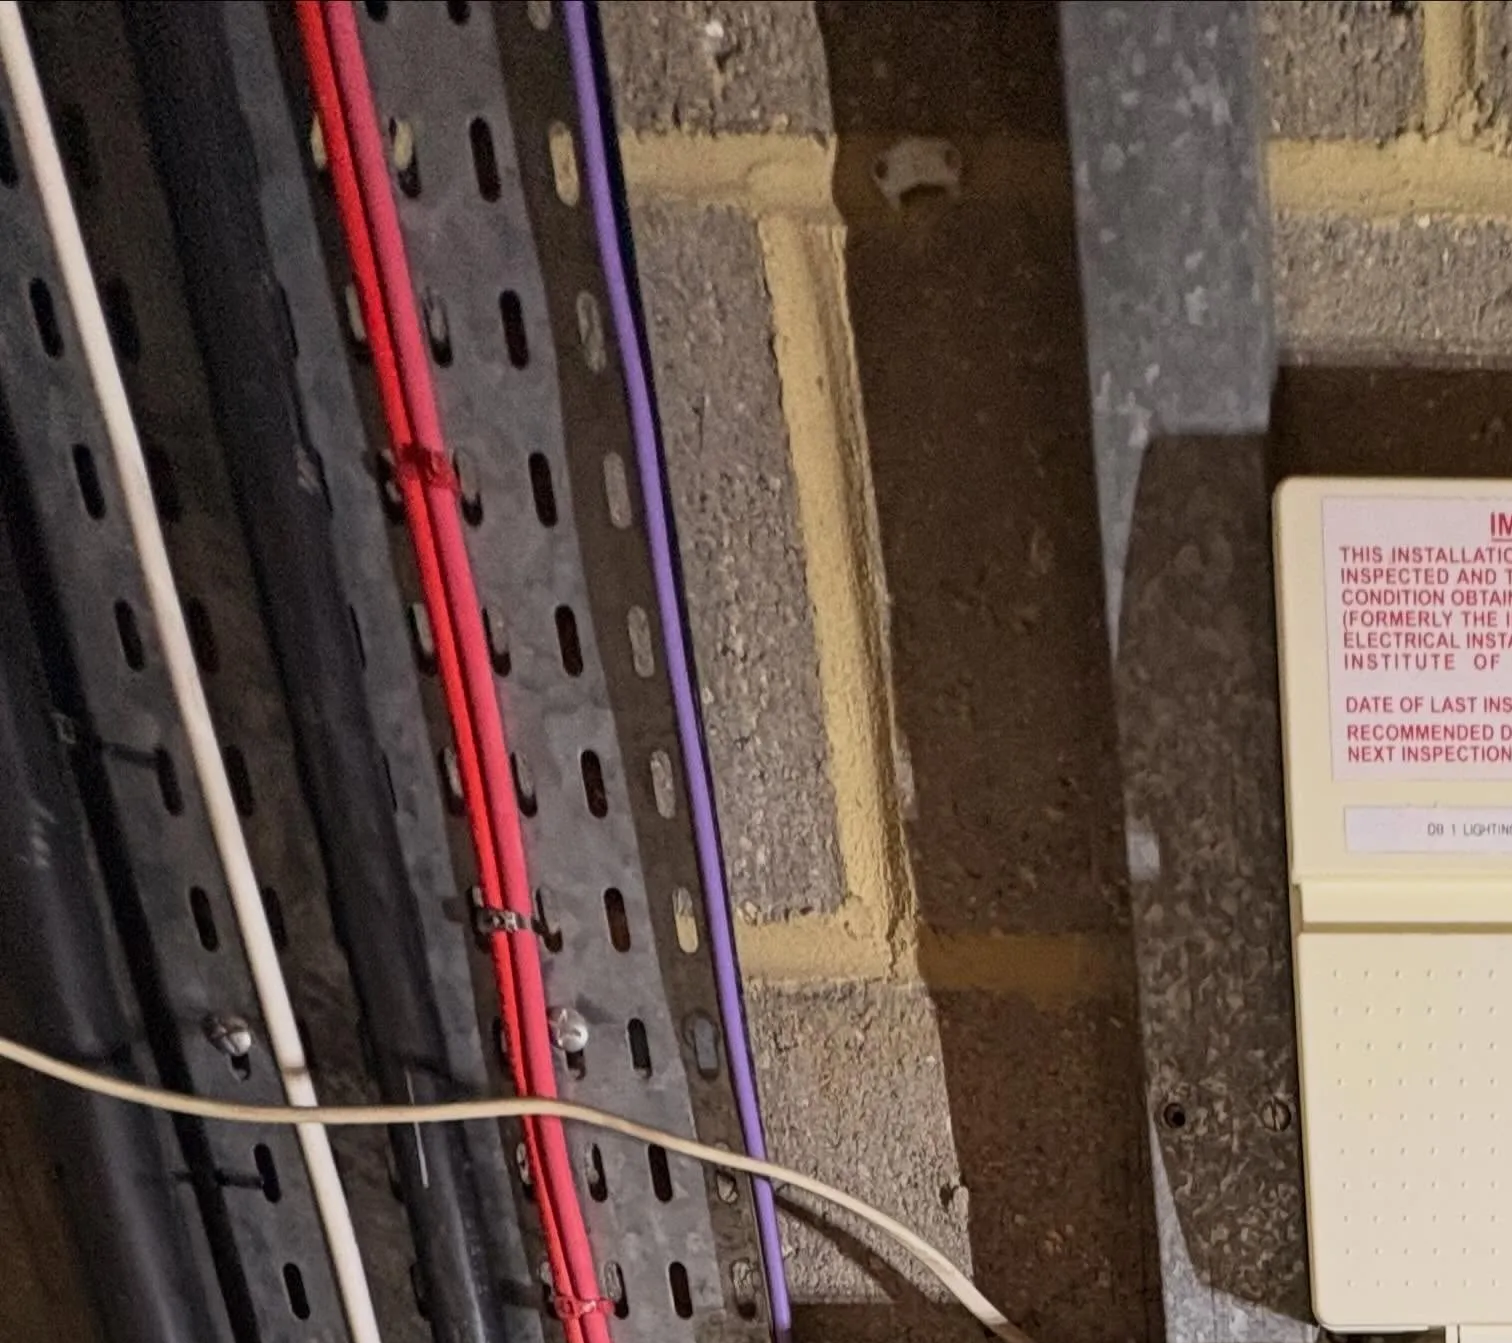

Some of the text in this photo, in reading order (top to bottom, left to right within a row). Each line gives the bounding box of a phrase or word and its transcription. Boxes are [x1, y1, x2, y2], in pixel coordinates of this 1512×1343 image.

[1339, 547, 1383, 565] THIS
[1341, 568, 1449, 586] INSPECTED
[1456, 568, 1497, 586] AND
[1341, 589, 1445, 609] CONDITION
[1343, 610, 1453, 630] (FORMERLY
[1460, 610, 1498, 628] THE
[1344, 631, 1461, 650] ELECTRICAL
[1344, 652, 1455, 671] INSTITUTE
[1472, 653, 1500, 671] OF
[1346, 696, 1394, 714] DATE
[1400, 696, 1424, 714] OF
[1431, 696, 1478, 714] LAST
[1347, 723, 1495, 742] RECOMMENDED
[1348, 745, 1396, 763] NEXT
[1427, 823, 1444, 836] DB
